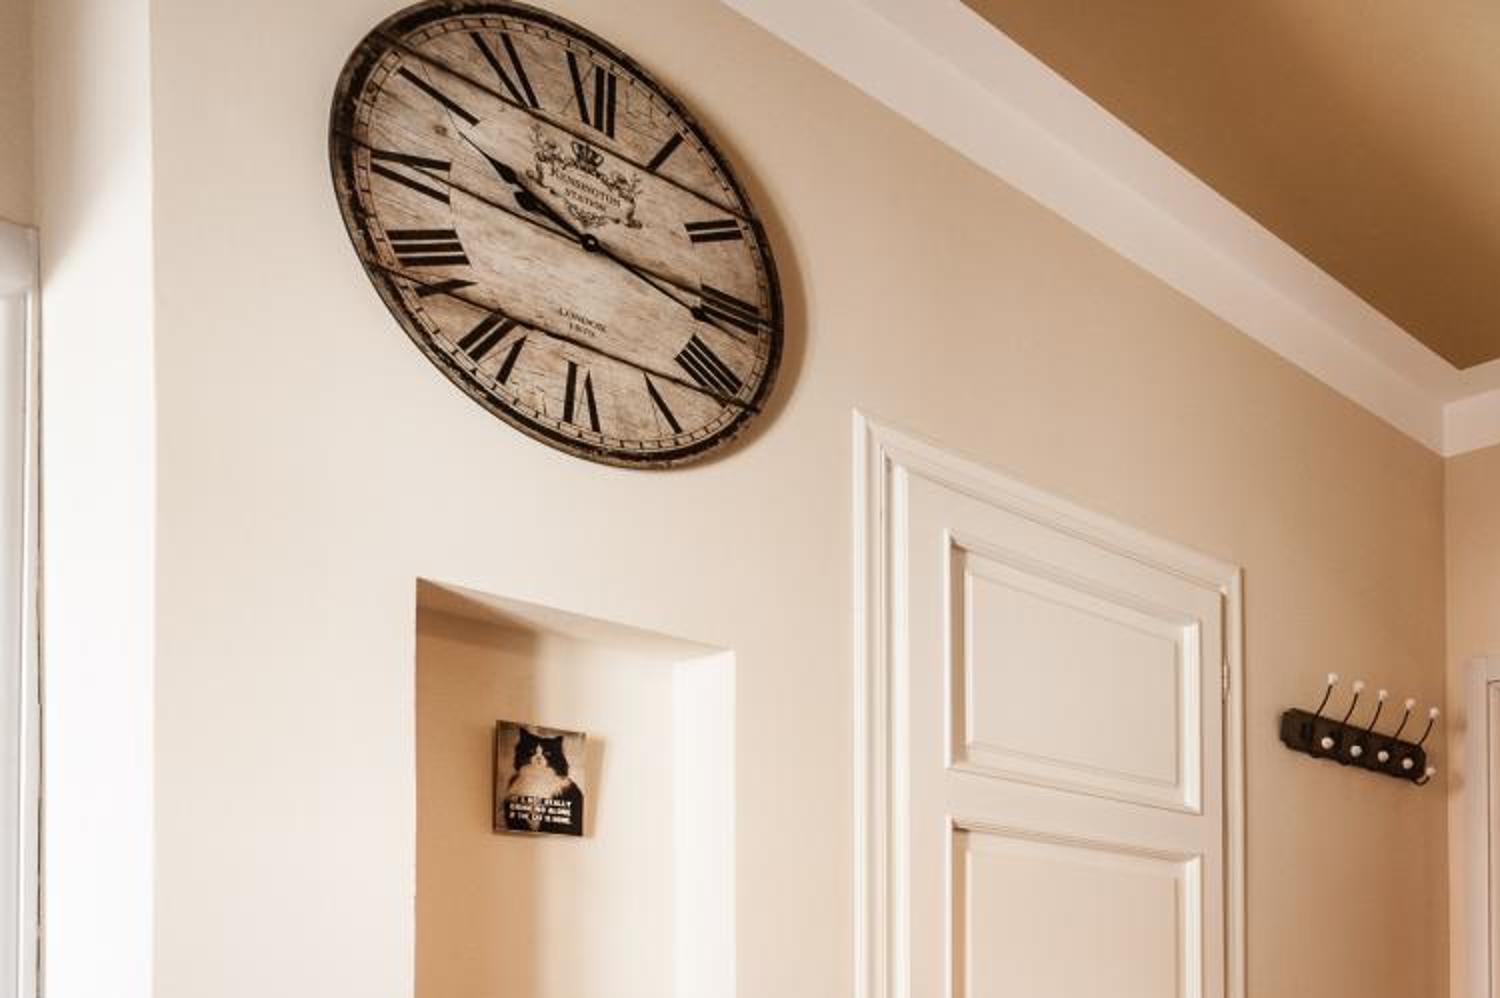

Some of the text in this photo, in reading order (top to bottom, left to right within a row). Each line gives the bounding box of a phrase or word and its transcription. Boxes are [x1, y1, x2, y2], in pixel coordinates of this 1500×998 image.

[561, 50, 617, 139] XII
[646, 133, 686, 171] I
[684, 218, 744, 244] II
